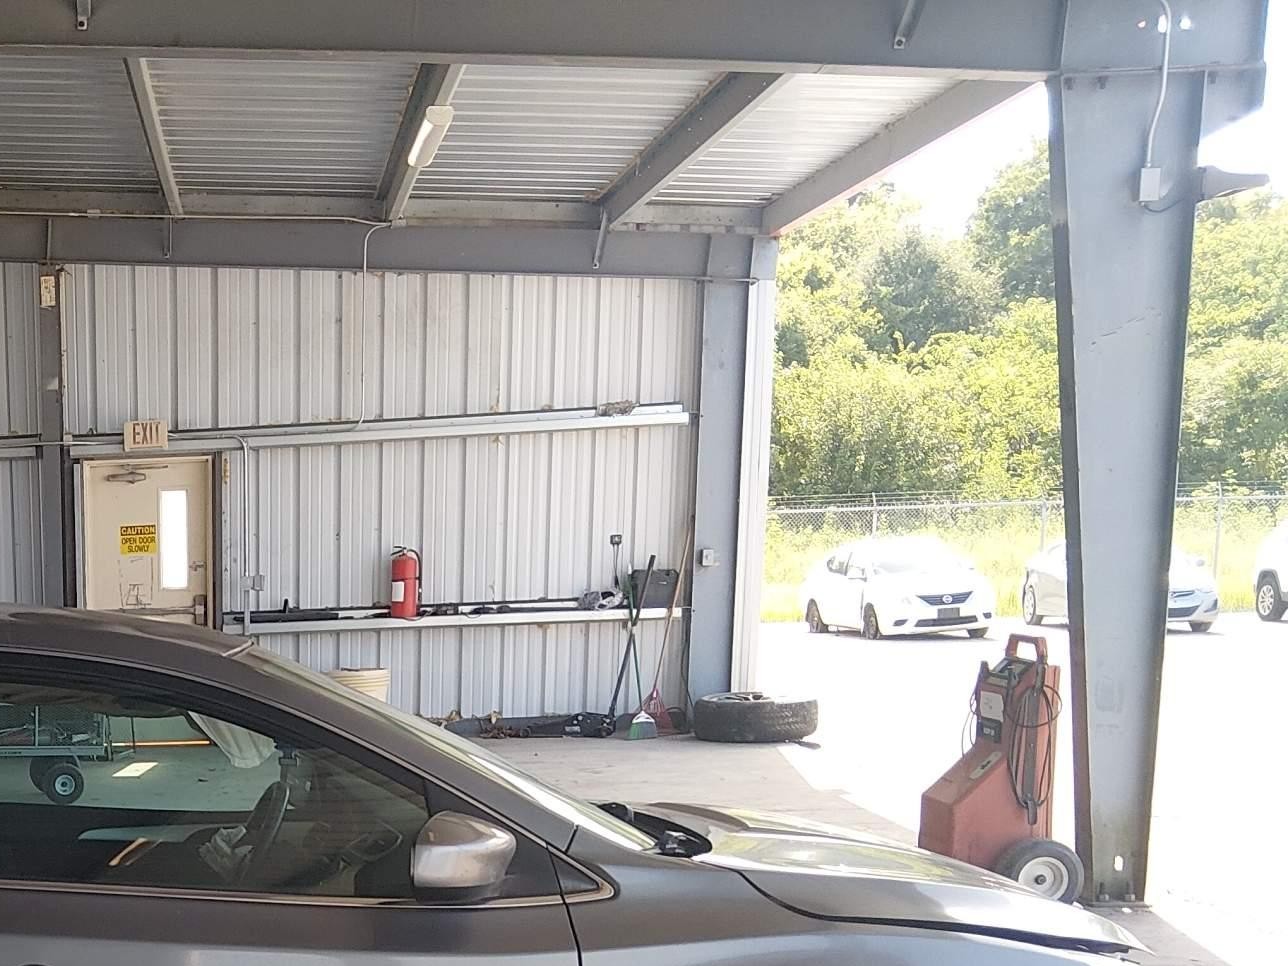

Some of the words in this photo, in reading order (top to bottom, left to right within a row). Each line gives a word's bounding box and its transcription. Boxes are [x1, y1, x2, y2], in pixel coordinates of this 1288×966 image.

[132, 421, 161, 445] EXIT
[121, 526, 156, 535] CAUTION
[121, 537, 137, 545] OPEN
[138, 536, 156, 544] DOOR
[127, 545, 150, 553] SLOWLY
